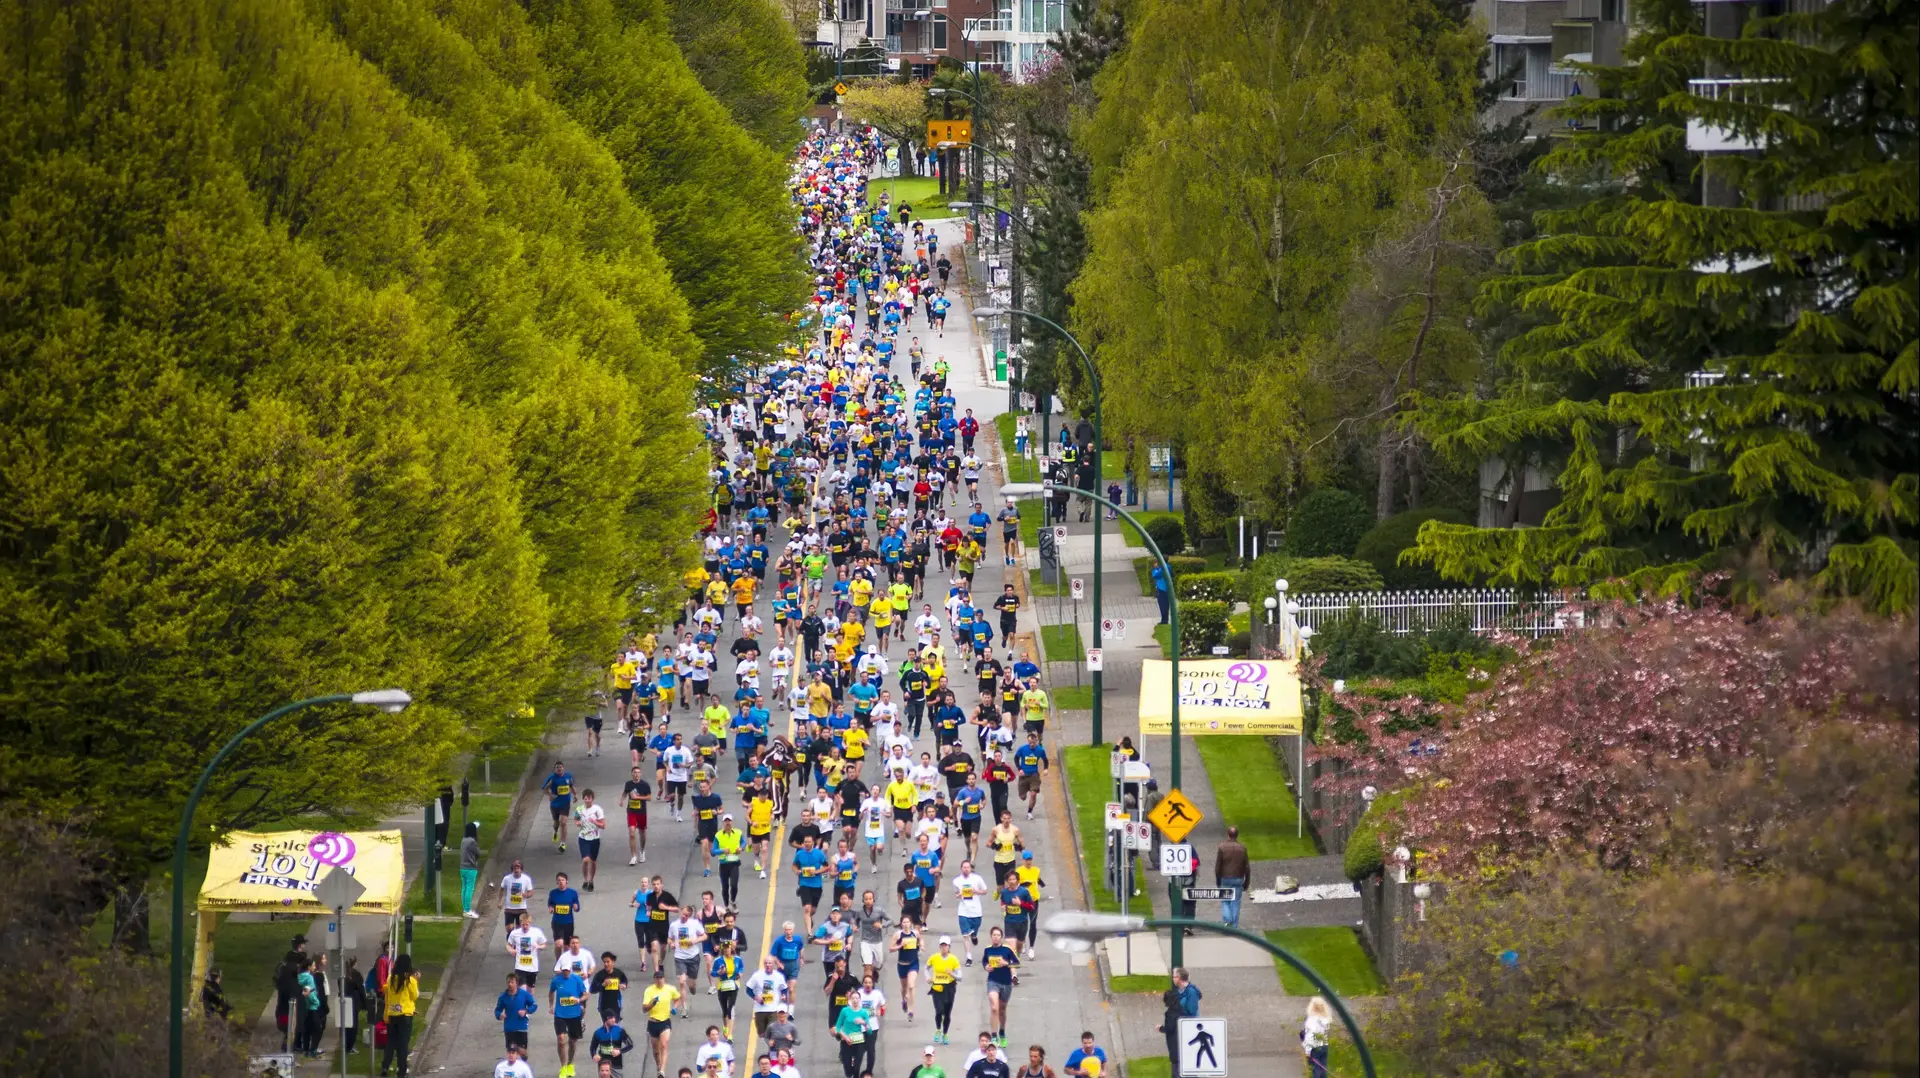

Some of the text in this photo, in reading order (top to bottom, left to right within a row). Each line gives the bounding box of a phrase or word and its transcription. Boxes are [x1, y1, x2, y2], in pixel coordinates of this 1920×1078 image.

[1222, 698, 1268, 709] NOW.
[1247, 722, 1295, 730] Commercials
[1166, 848, 1187, 863] 30
[1191, 890, 1220, 899] THURLOW
